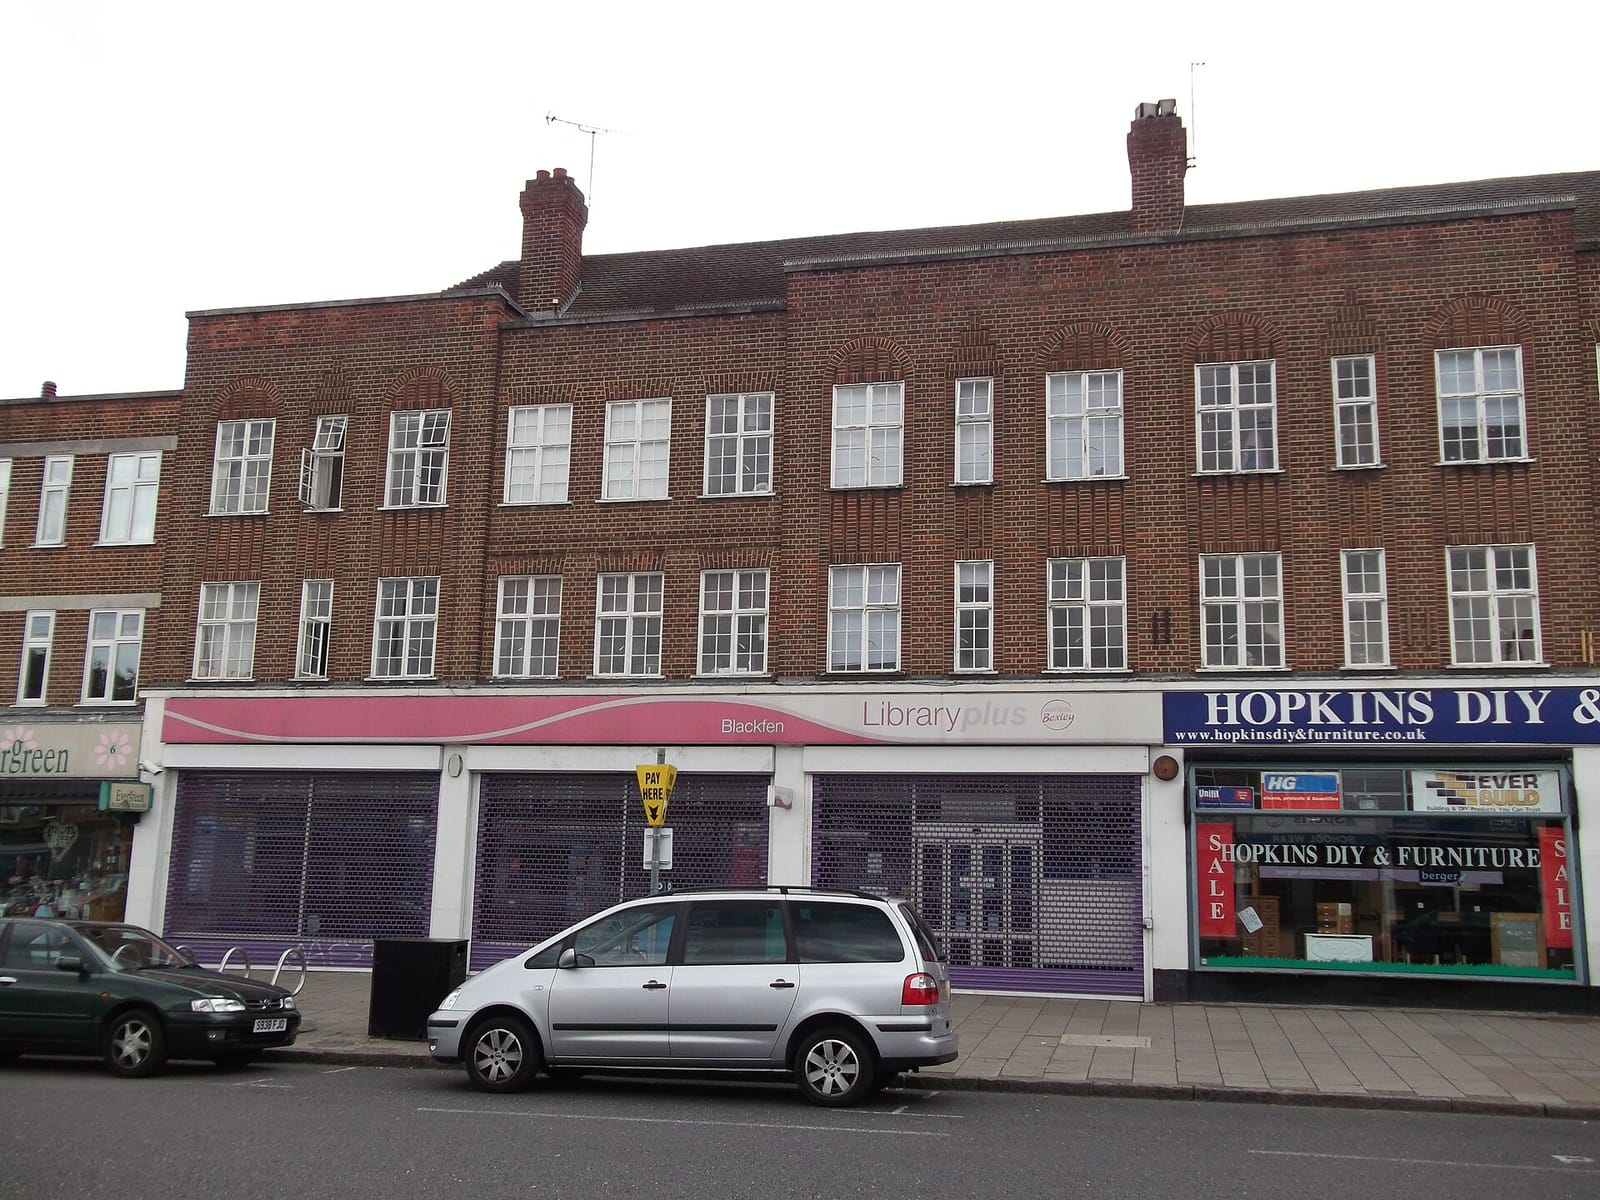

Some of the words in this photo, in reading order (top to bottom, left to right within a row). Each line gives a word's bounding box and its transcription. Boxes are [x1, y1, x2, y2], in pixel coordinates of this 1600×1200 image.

[1204, 690, 1434, 725] HOPKINS
[1453, 690, 1551, 724] DIY
[1572, 688, 1600, 724] &
[863, 701, 961, 732] Library
[960, 700, 1027, 732] plus
[1042, 712, 1075, 723] Bexley
[721, 719, 784, 733] Blackfen
[1175, 728, 1426, 743] www.hopkinsdiy&furniture.co.uk
[110, 744, 116, 754] 6
[645, 772, 661, 785] PAY
[1267, 776, 1297, 790] HG
[1478, 774, 1539, 789] EVER
[642, 787, 664, 800] HERE
[1478, 789, 1541, 806] BUILD
[1220, 843, 1318, 864] HOPKINS
[1325, 845, 1365, 865] DIY
[1373, 846, 1390, 866] &
[1397, 846, 1541, 868] FURNITURE
[1208, 834, 1225, 920] SALE
[1421, 871, 1459, 881] berger
[1553, 839, 1571, 930] SALE
